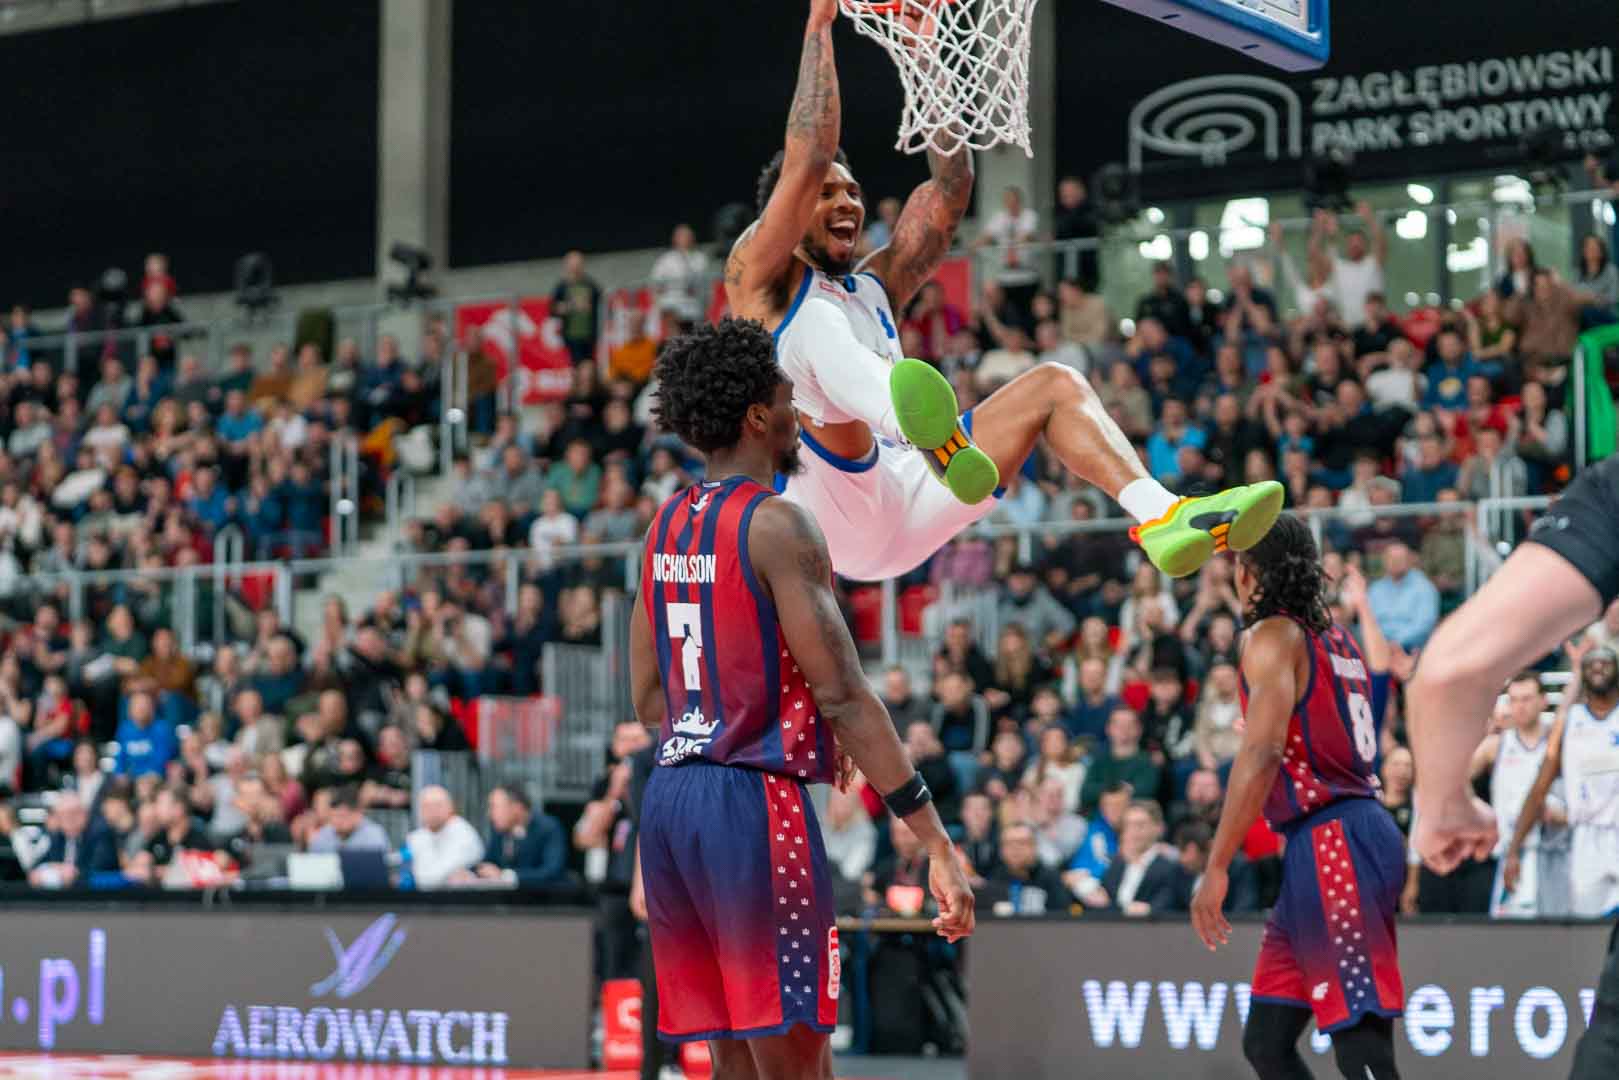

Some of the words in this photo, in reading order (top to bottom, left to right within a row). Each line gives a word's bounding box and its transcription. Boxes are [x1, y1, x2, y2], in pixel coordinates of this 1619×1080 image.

[1311, 46, 1613, 115] ZAGŁĘBIOWSKI
[1311, 114, 1402, 157] PARK
[1408, 92, 1611, 146] SPORTOWY
[652, 552, 716, 584] NCHOLSON
[666, 602, 702, 691] 7
[1347, 692, 1377, 763] 8
[0, 928, 107, 1048] .pl
[212, 1003, 508, 1064] AEROWATCH
